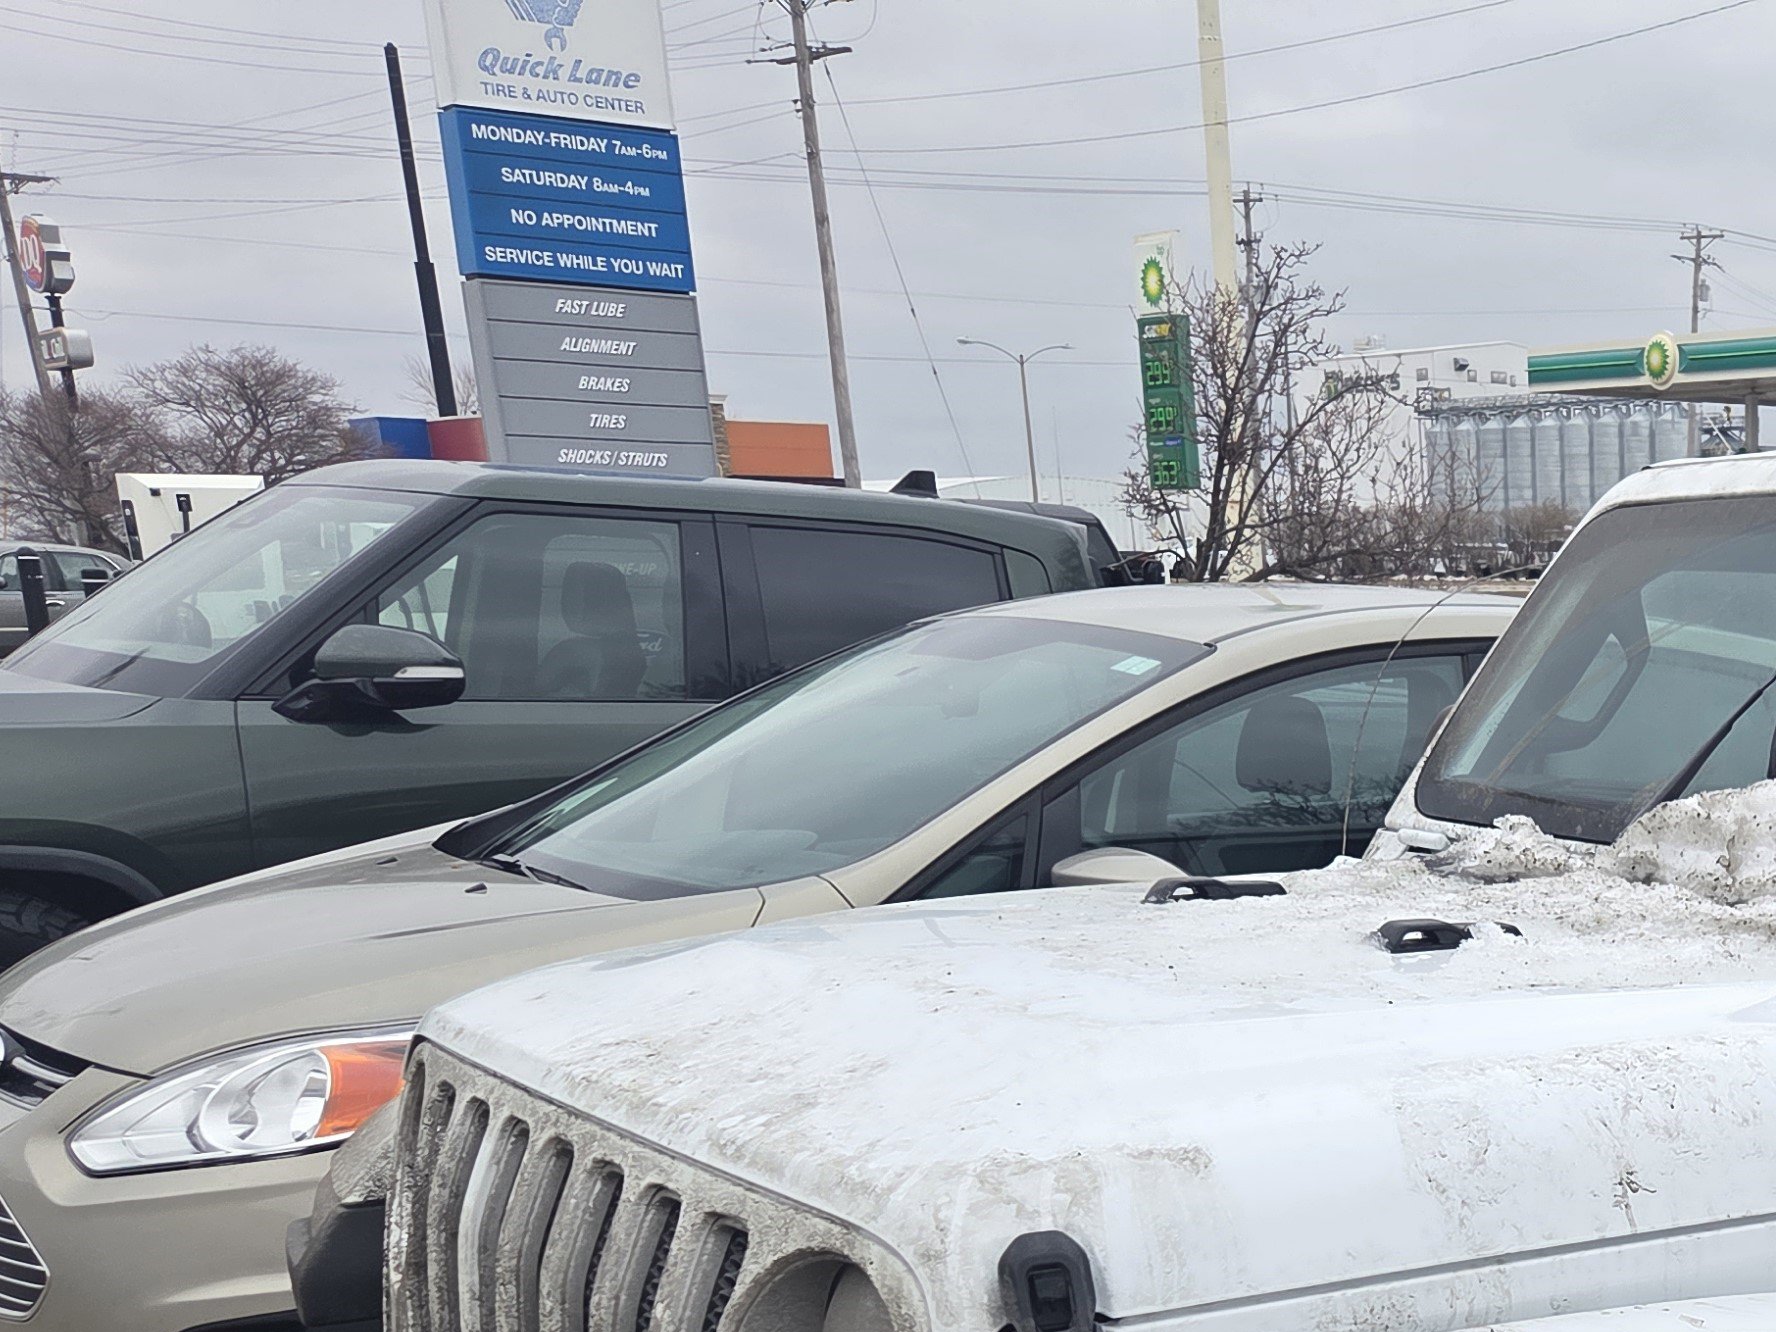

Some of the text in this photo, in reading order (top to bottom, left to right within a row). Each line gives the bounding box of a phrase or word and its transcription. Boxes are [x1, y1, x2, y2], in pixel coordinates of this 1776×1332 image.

[478, 47, 641, 89] Quick Lane
[480, 82, 646, 114] TIRE & AUTO CENTER
[471, 124, 607, 153] MONDAY-FRIDAY
[501, 167, 588, 190] SATURDAY
[511, 209, 658, 237] NO APPOINTMENT
[485, 246, 684, 279] SERVICE WHILE YOU WAIT
[555, 299, 626, 317] FAST LUBE
[560, 337, 637, 356] ALIGNMENT
[578, 376, 630, 392] BRAKES
[589, 414, 626, 428] TIRES
